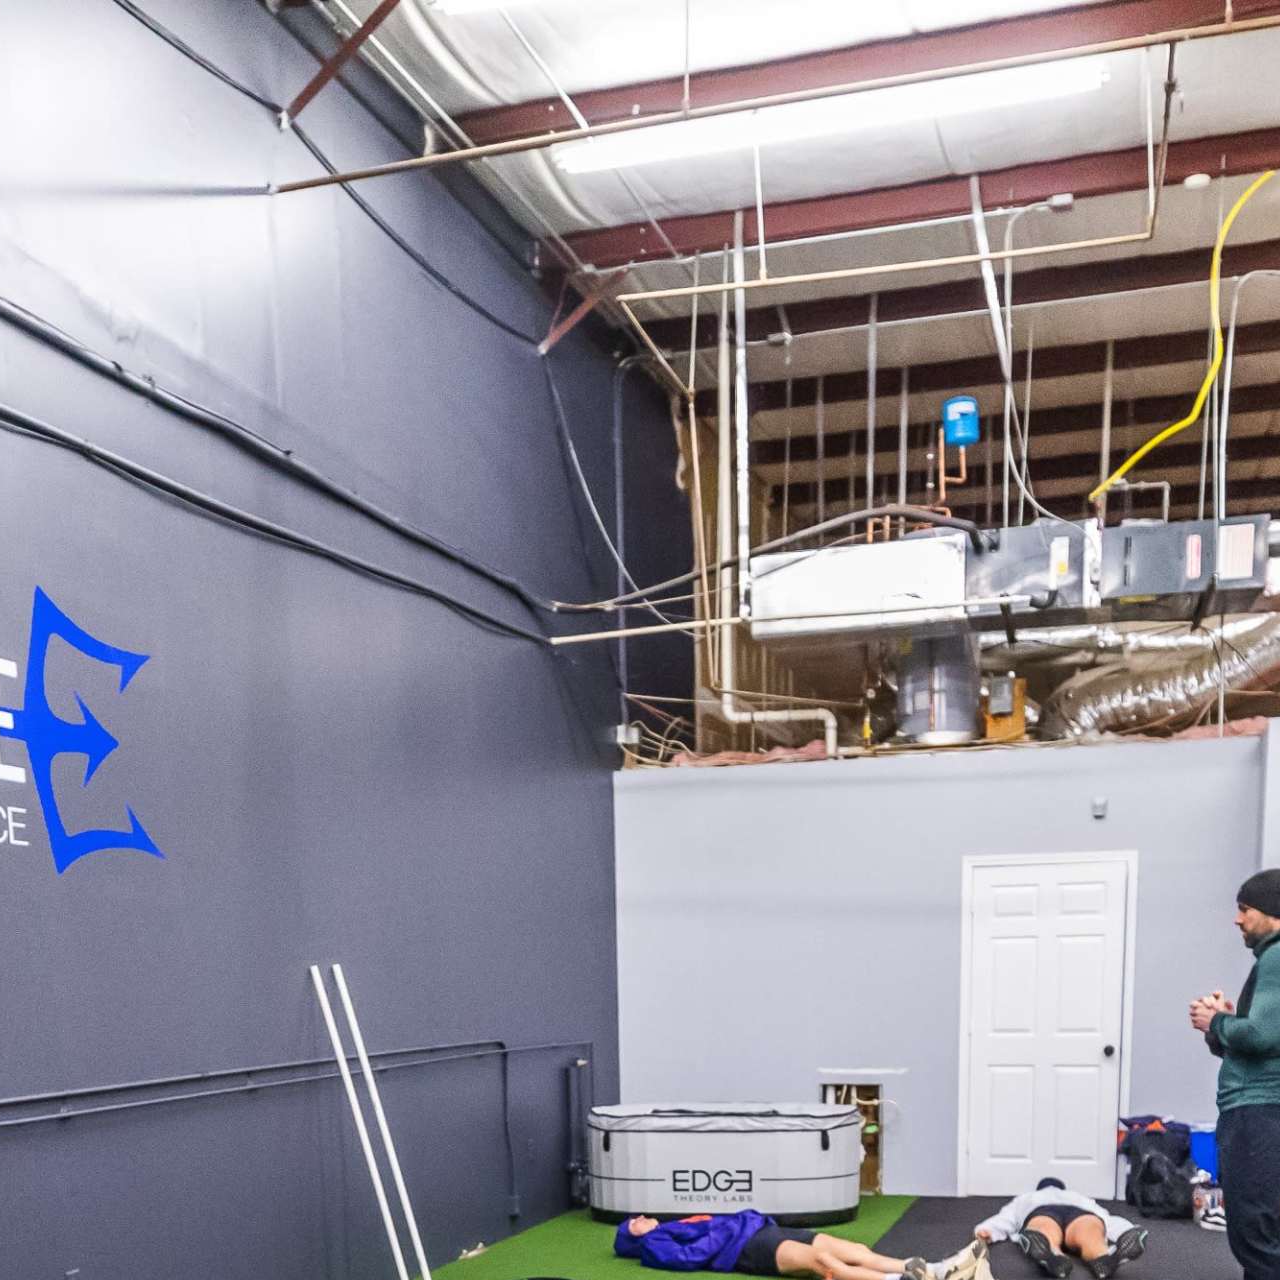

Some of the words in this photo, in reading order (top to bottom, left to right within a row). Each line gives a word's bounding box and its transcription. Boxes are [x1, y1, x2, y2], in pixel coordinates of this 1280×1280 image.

[672, 1169, 753, 1192] EDGE
[673, 1194, 718, 1203] THEORY
[723, 1194, 753, 1203] LABS
